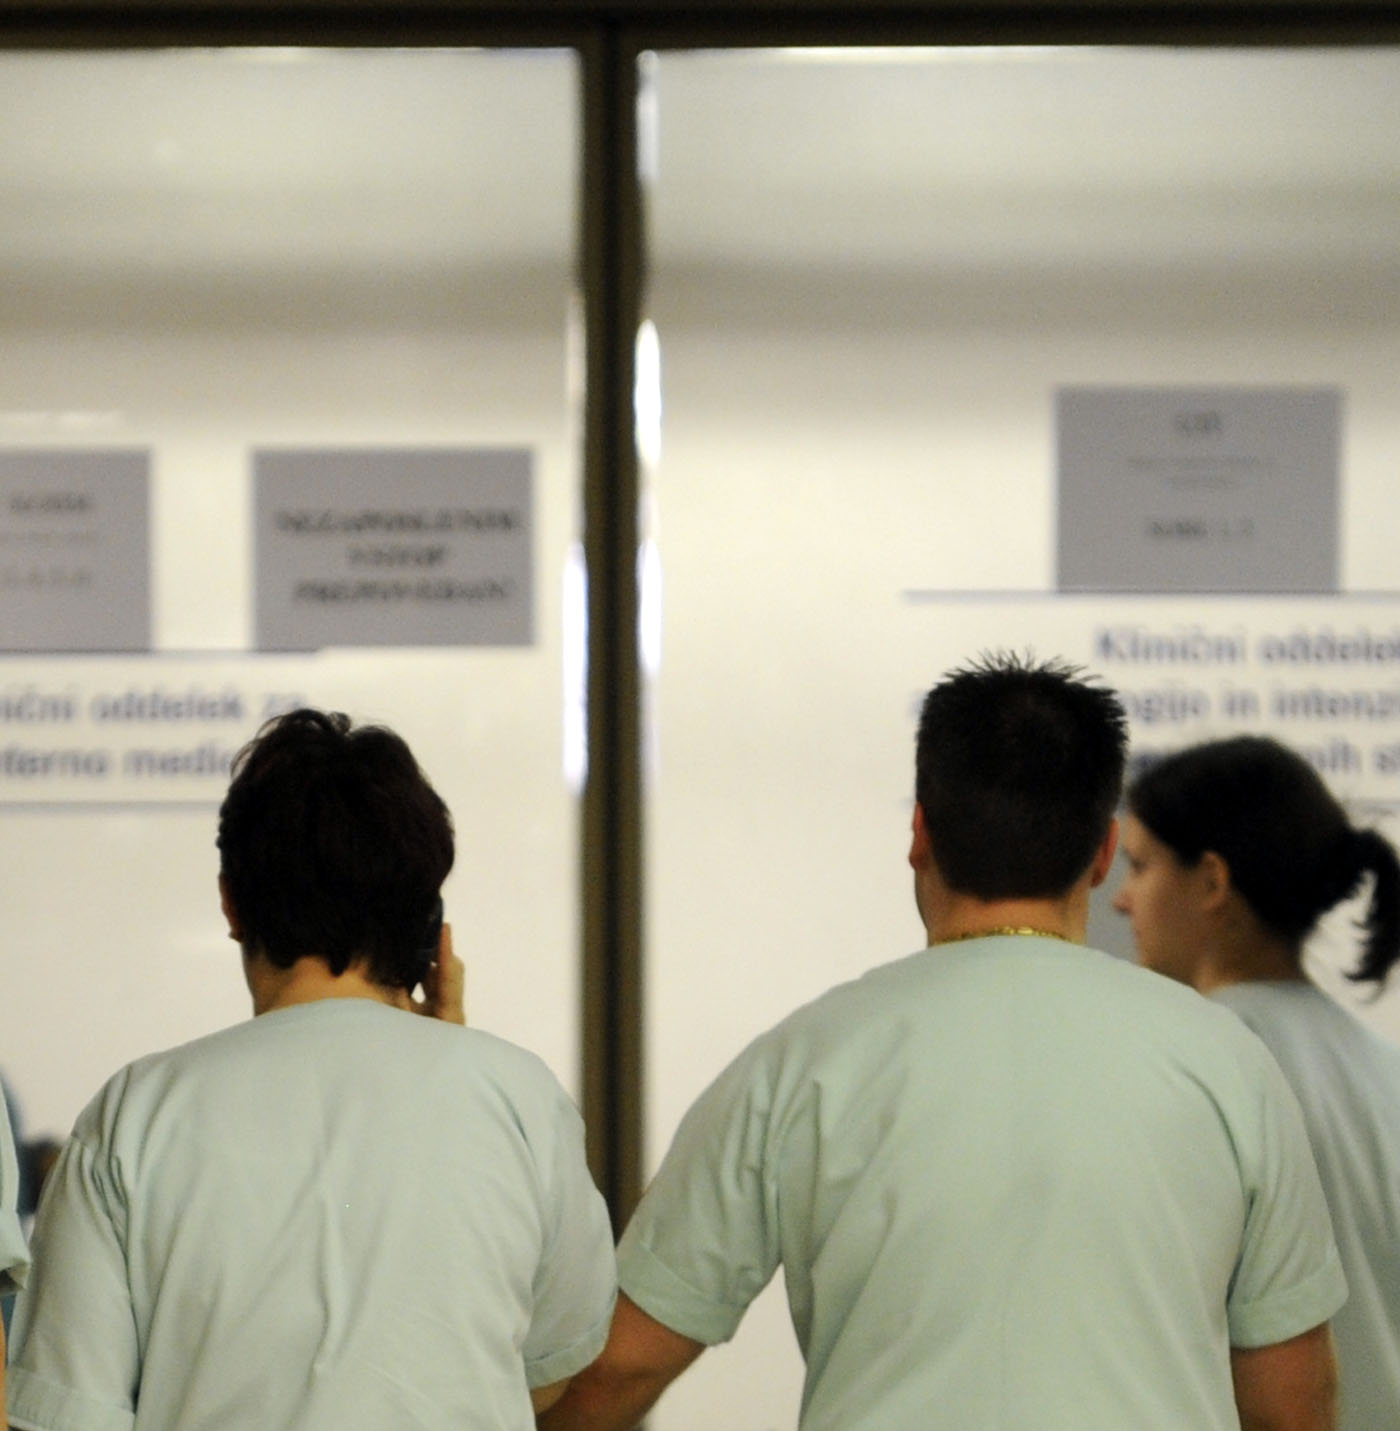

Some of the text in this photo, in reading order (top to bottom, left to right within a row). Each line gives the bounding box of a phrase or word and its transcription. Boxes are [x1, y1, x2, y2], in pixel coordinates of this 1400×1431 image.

[1097, 623, 1247, 664] Klinični
[90, 685, 243, 722] oddelek
[1223, 681, 1260, 718] in
